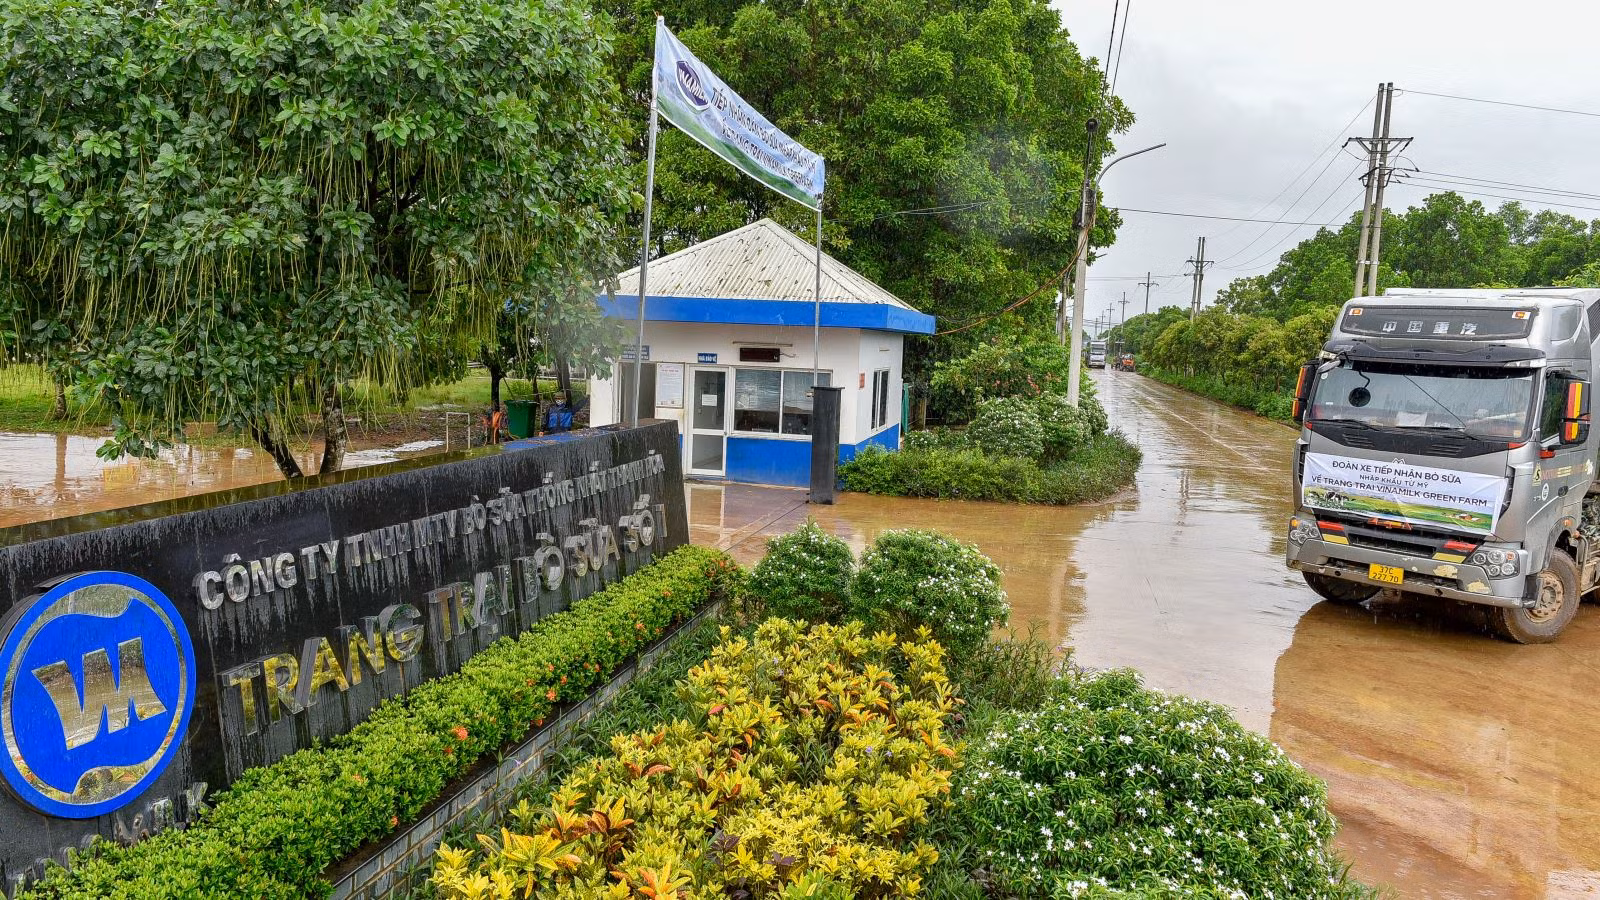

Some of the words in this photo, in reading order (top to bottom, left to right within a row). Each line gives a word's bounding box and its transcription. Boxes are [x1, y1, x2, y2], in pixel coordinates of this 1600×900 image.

[1332, 460, 1358, 471] ĐOÀN
[1360, 464, 1371, 472] XE
[1373, 464, 1393, 475] TIẾP
[1424, 472, 1440, 481] BÒ
[1441, 473, 1462, 484] SỮA
[1405, 478, 1415, 487] TỪ
[1416, 481, 1429, 489] MỸ
[1311, 474, 1324, 483] VỀ
[1324, 477, 1353, 488] TRANG
[1376, 485, 1421, 498] VINAMILK
[1422, 491, 1457, 503] GREEN
[1458, 496, 1488, 507] FARM
[194, 553, 297, 611] CÔNG
[301, 540, 340, 580] TY
[345, 522, 411, 567] TNHH
[458, 494, 487, 535] BÒ
[486, 486, 527, 527] SỮA
[525, 472, 575, 515] THỐNG
[219, 604, 425, 736] TRANG
[425, 571, 516, 643] TRẠI
[514, 532, 565, 604] BÒ
[565, 518, 621, 577] SỮA
[618, 493, 655, 553] SỐ
